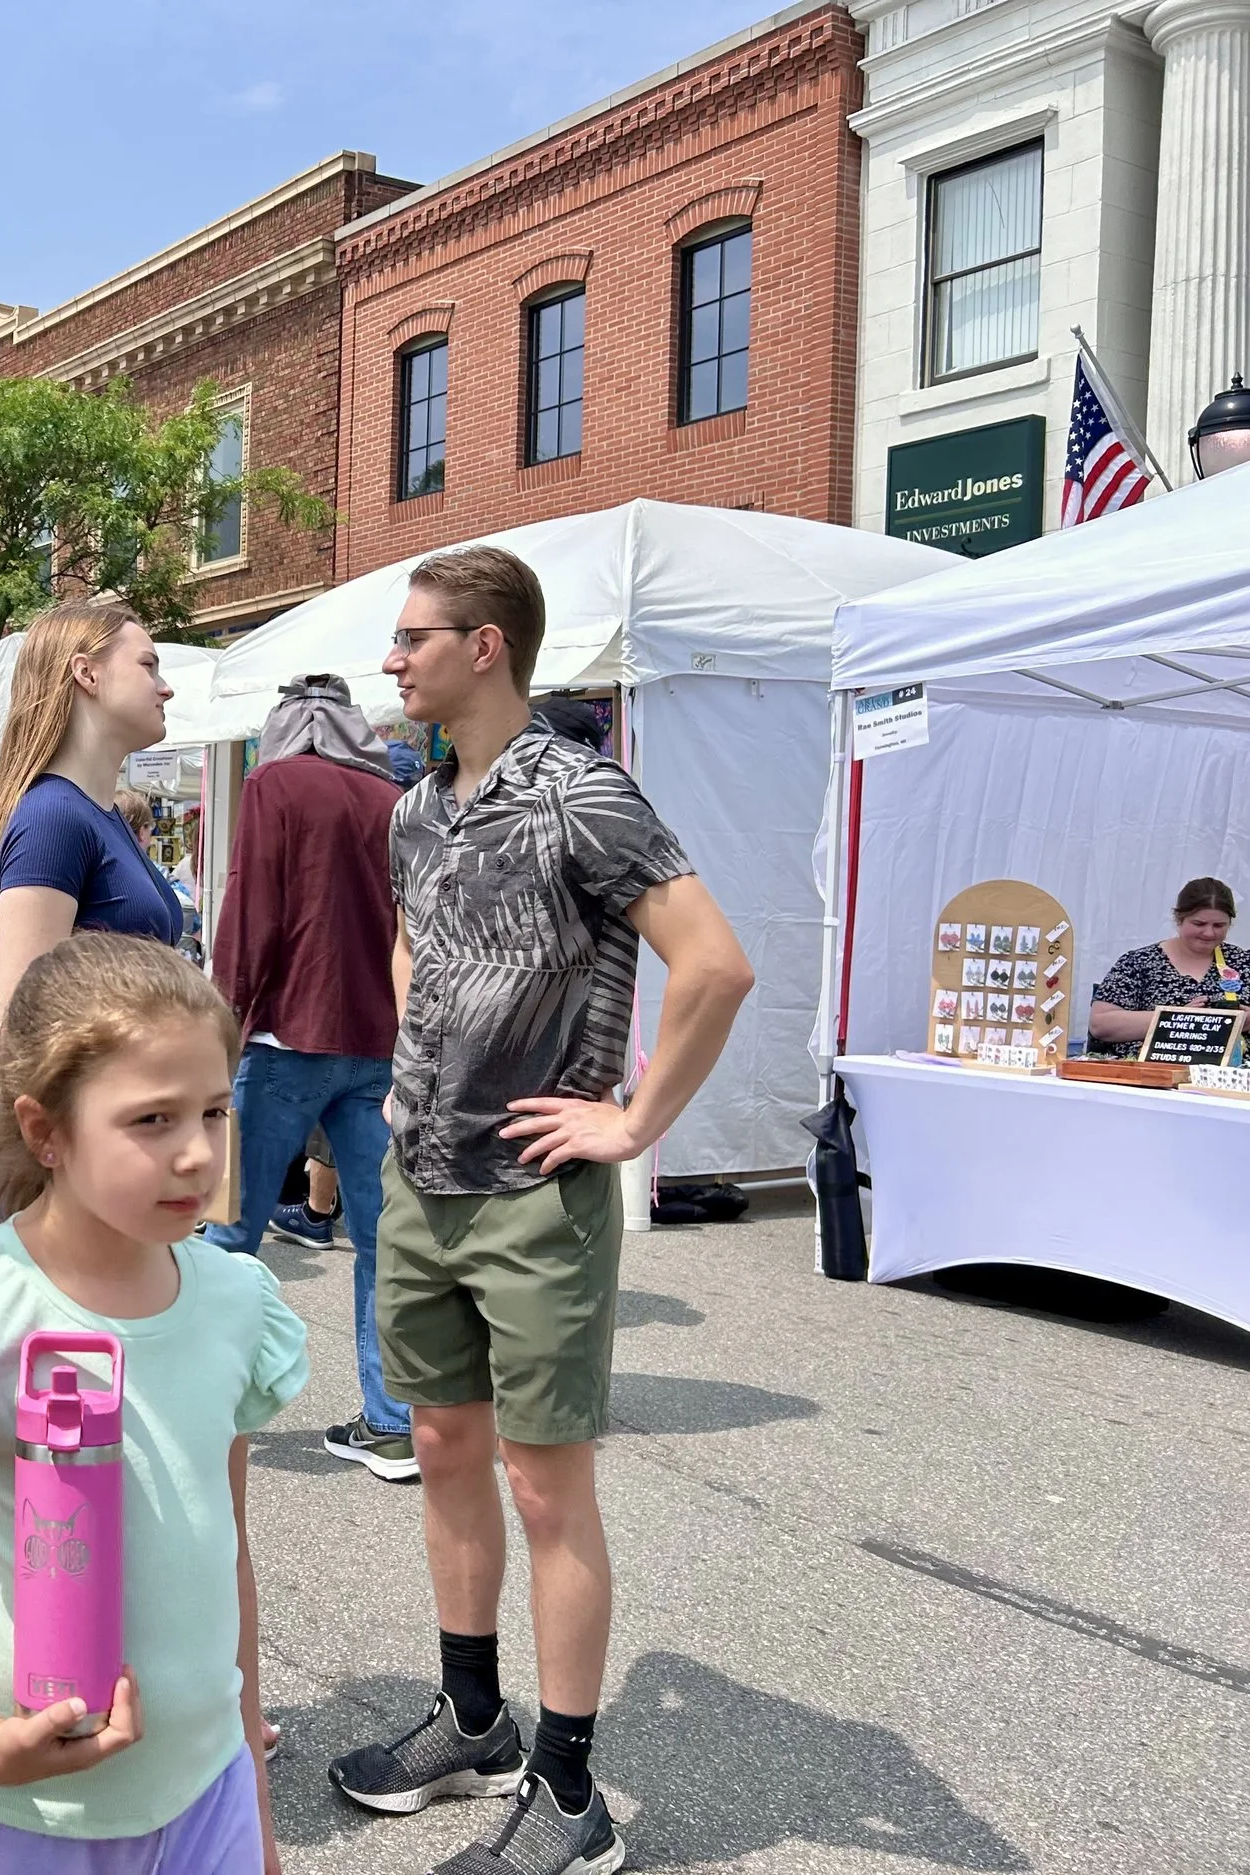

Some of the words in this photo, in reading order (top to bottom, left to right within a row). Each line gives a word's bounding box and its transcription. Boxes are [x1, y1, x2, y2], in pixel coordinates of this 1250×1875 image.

[963, 473, 1023, 501] Jones
[905, 513, 1010, 541] INVESTMENTS
[873, 717, 893, 728] Smith
[894, 710, 923, 722] Studios
[1171, 1014, 1223, 1023] LIGHTWEIGHT
[1159, 1021, 1195, 1030] POLYMER
[1202, 1024, 1222, 1032] CLAY
[1169, 1031, 1208, 1040] EARRINGS
[1154, 1041, 1187, 1051] DANGLES
[1150, 1053, 1177, 1061] STUDS
[31, 1679, 76, 1697] YETI
